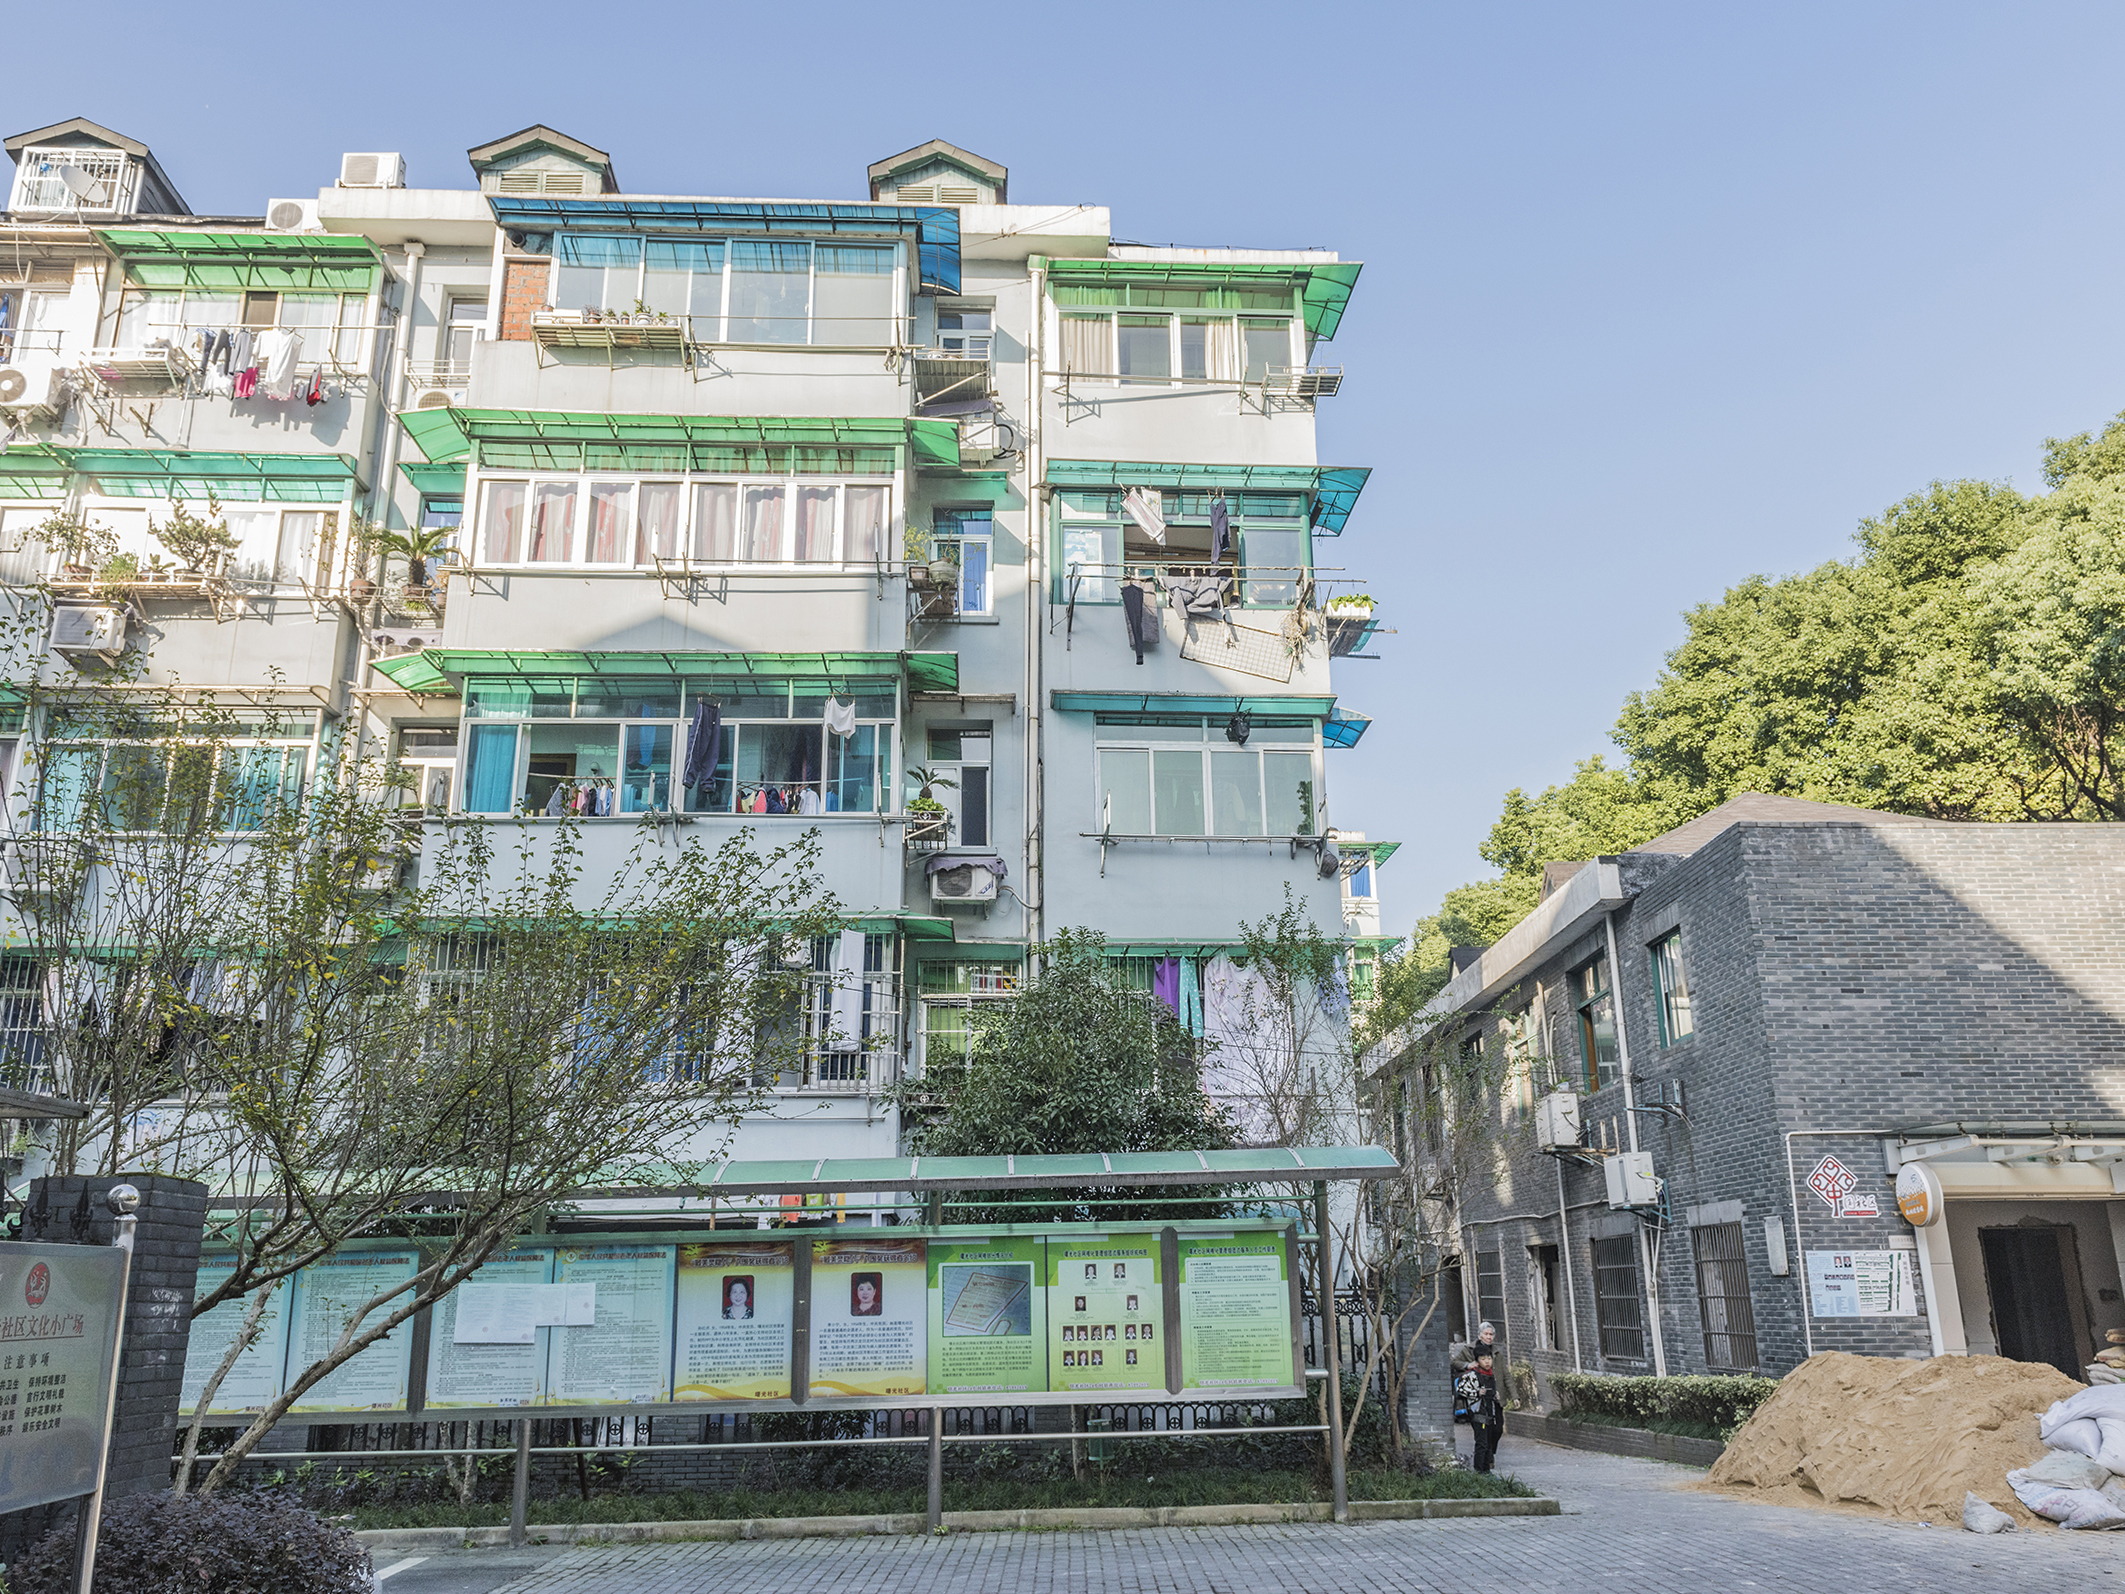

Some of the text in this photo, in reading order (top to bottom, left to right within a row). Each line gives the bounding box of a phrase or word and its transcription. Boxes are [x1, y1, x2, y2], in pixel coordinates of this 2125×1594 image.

[0, 1314, 84, 1339] 社区文化小广场
[28, 1374, 67, 1389] 保持环境整洁
[754, 1390, 779, 1398] 曙光社区
[24, 1402, 63, 1418] 保护花草树木
